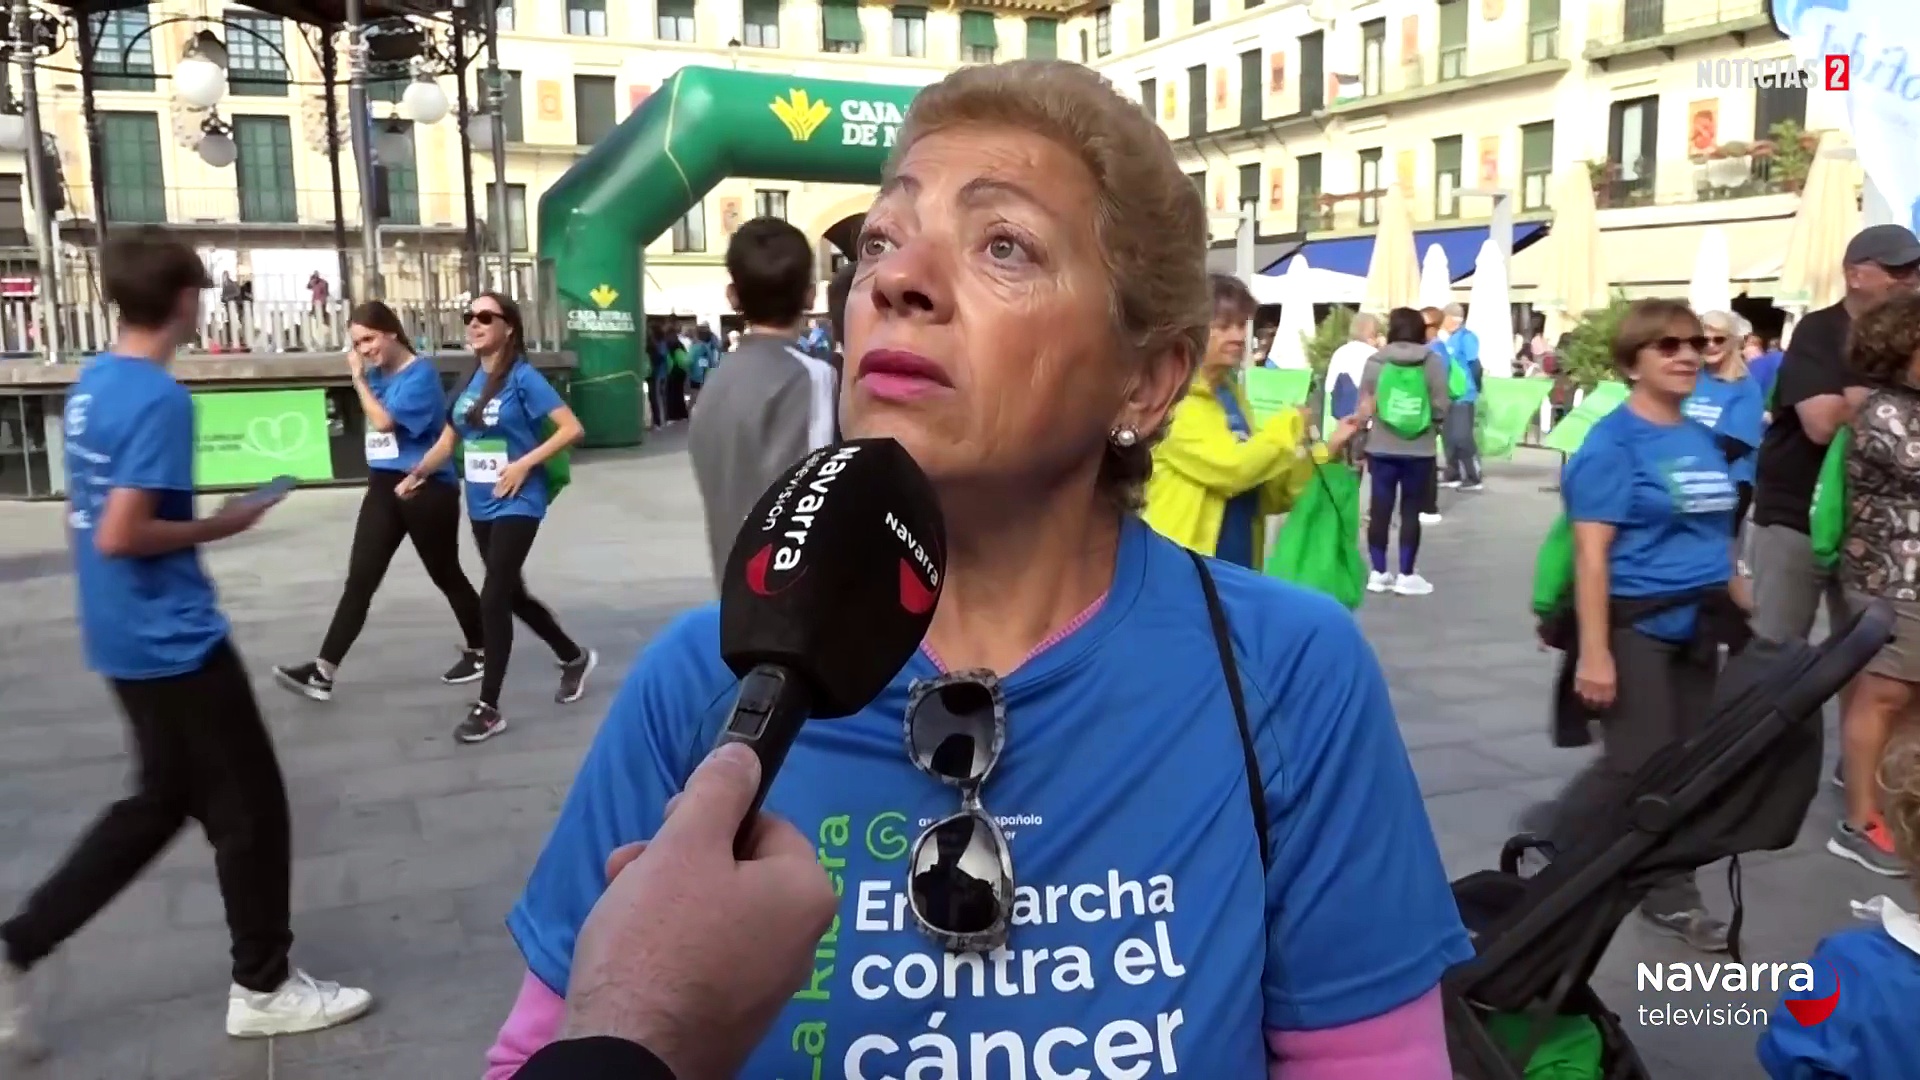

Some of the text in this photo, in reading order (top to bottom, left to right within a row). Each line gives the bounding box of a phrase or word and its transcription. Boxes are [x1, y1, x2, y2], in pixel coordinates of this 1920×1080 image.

[841, 99, 904, 123] CAJA
[842, 122, 878, 147] DE
[773, 446, 861, 571] Navarra
[884, 511, 939, 587] Navarra
[995, 814, 1042, 827] spañola
[1010, 869, 1175, 925] archa
[852, 920, 1186, 1000] contra el
[843, 1008, 1185, 1080] cáncer
